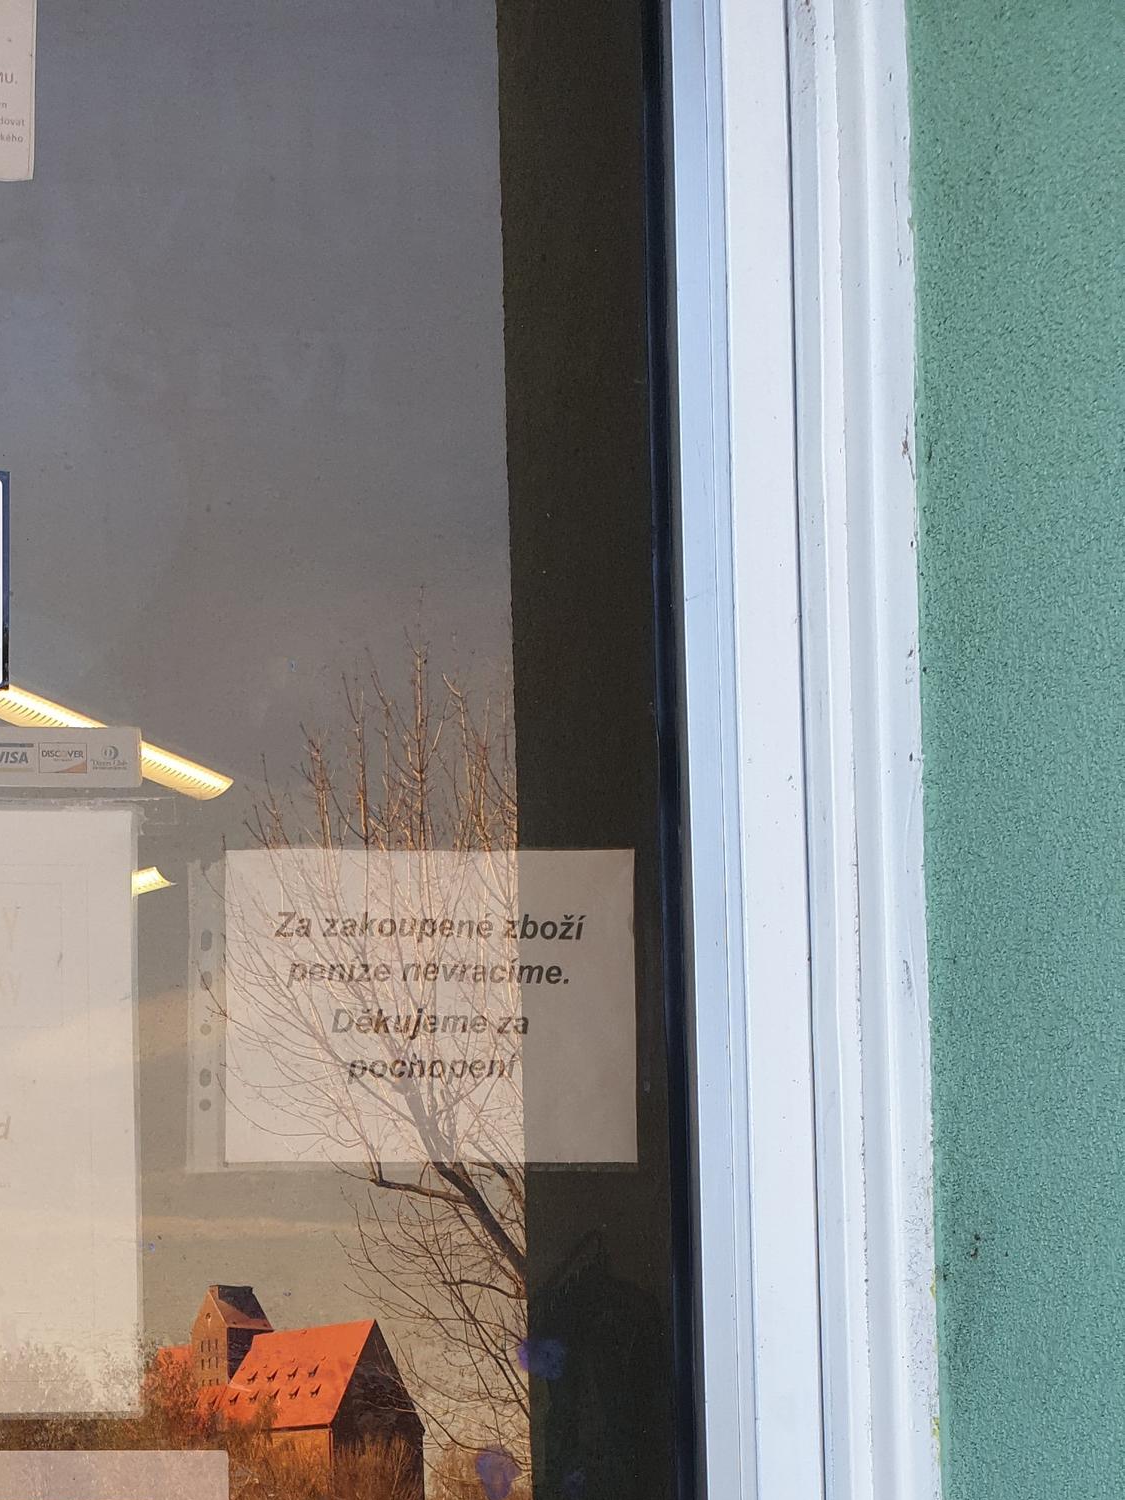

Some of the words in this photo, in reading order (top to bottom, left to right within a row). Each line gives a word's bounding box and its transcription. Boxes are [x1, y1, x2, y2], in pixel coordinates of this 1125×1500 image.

[41, 749, 84, 759] DISCOVER
[274, 912, 311, 940] Za
[320, 911, 494, 943] zakoupené
[504, 914, 587, 941] zboží
[287, 955, 393, 987] peníze
[402, 958, 570, 985] nevracíme.
[332, 1006, 487, 1040] Děkujeme
[497, 1015, 529, 1035] za
[347, 1052, 516, 1085] pochopení
